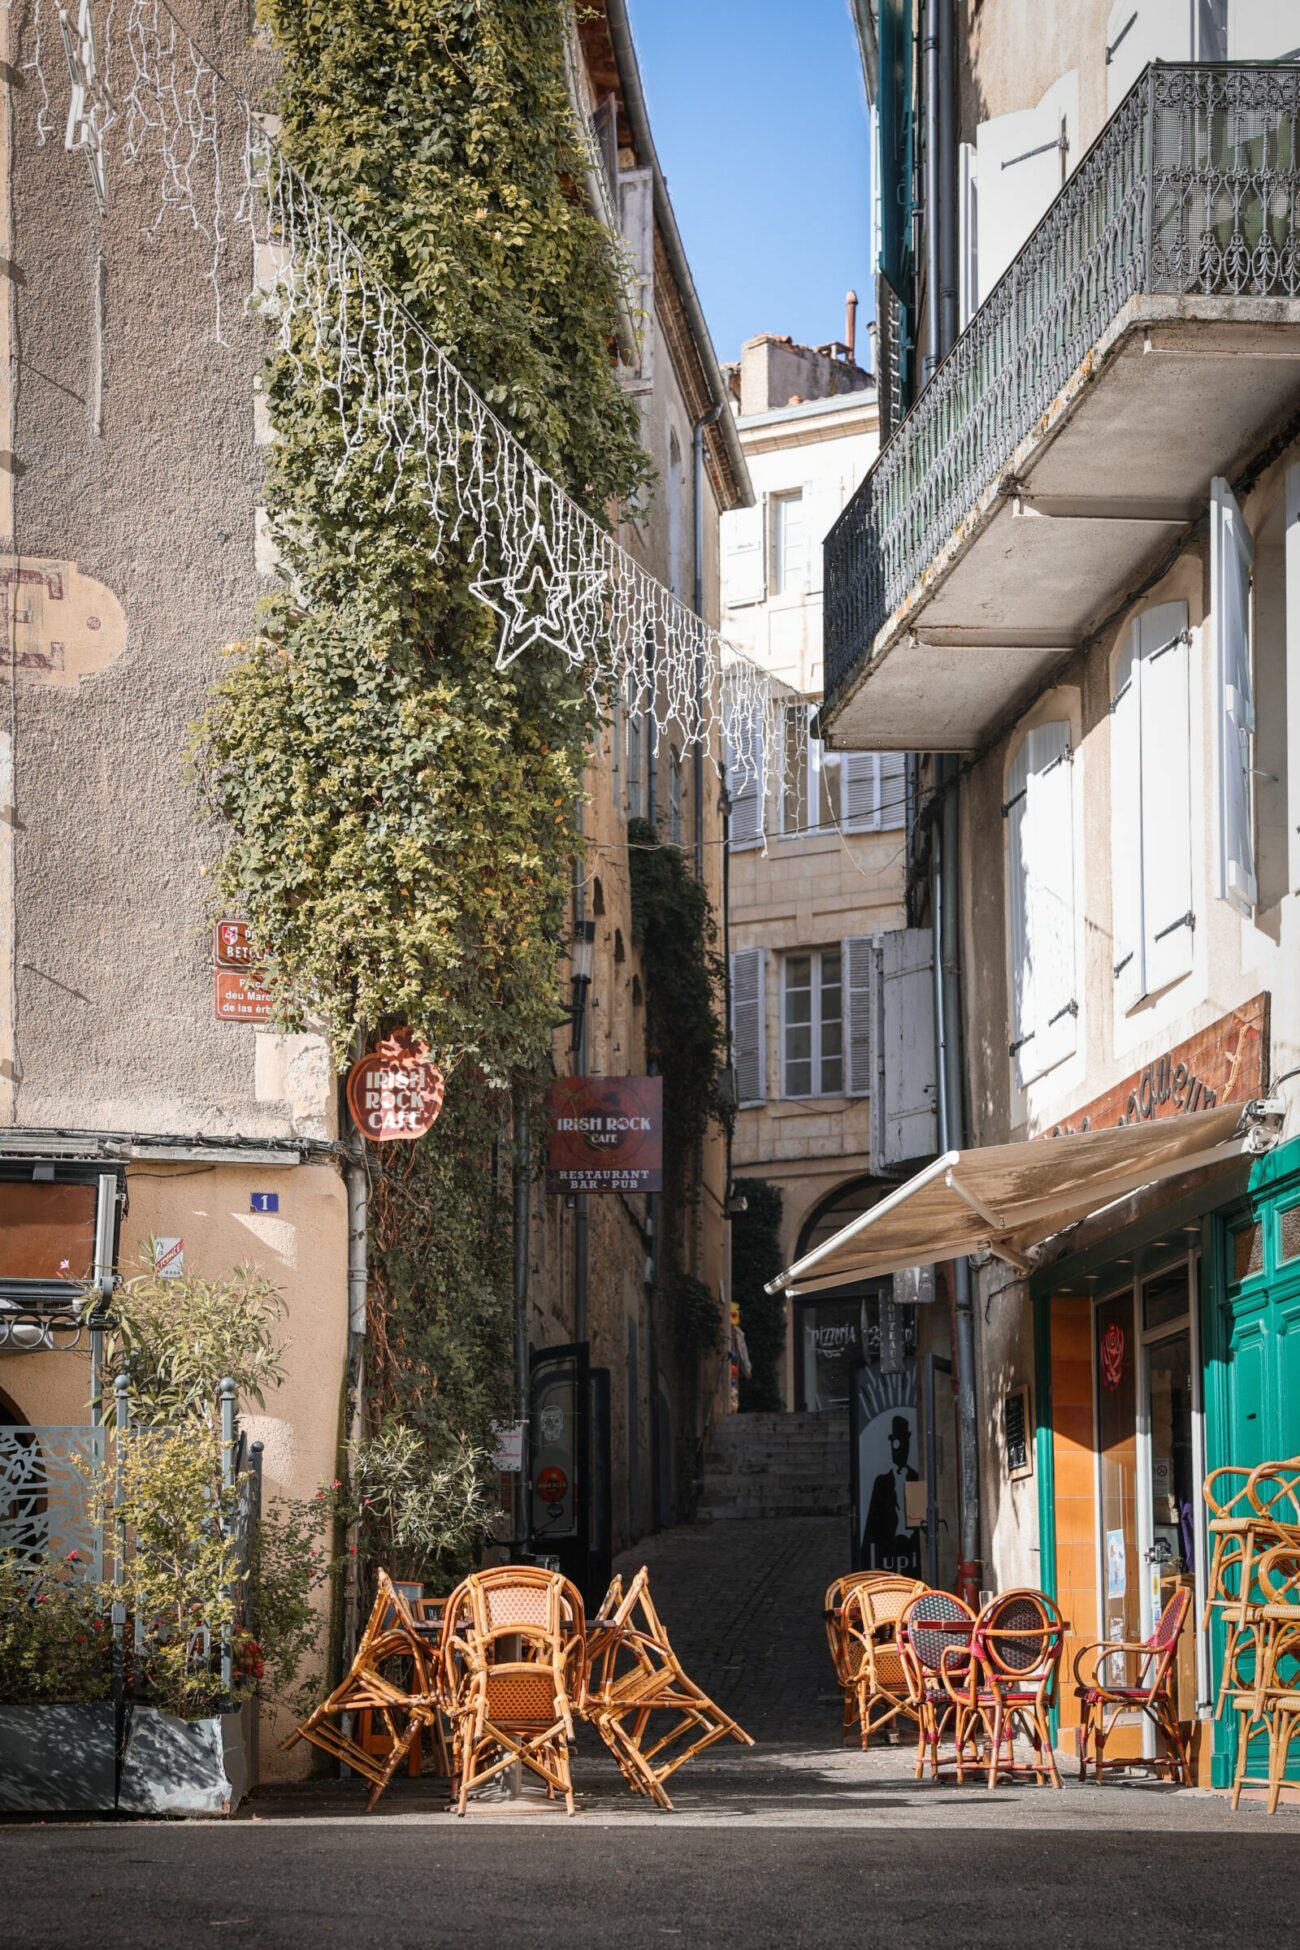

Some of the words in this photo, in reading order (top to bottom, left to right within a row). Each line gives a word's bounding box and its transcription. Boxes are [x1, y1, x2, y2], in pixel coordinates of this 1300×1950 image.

[225, 990, 244, 1000] deu
[247, 991, 271, 1002] Marc
[223, 1003, 235, 1012] de
[238, 1003, 253, 1013] las
[366, 1070, 426, 1089] IRISH
[365, 1091, 424, 1109] ROCK
[557, 1117, 602, 1131] IRISH
[606, 1116, 651, 1130] ROCK
[591, 1133, 617, 1143] CAFE
[560, 1169, 649, 1179] RESTAURANT
[570, 1180, 598, 1189] BAR
[611, 1180, 638, 1188] PUB
[260, 1195, 268, 1211] 1
